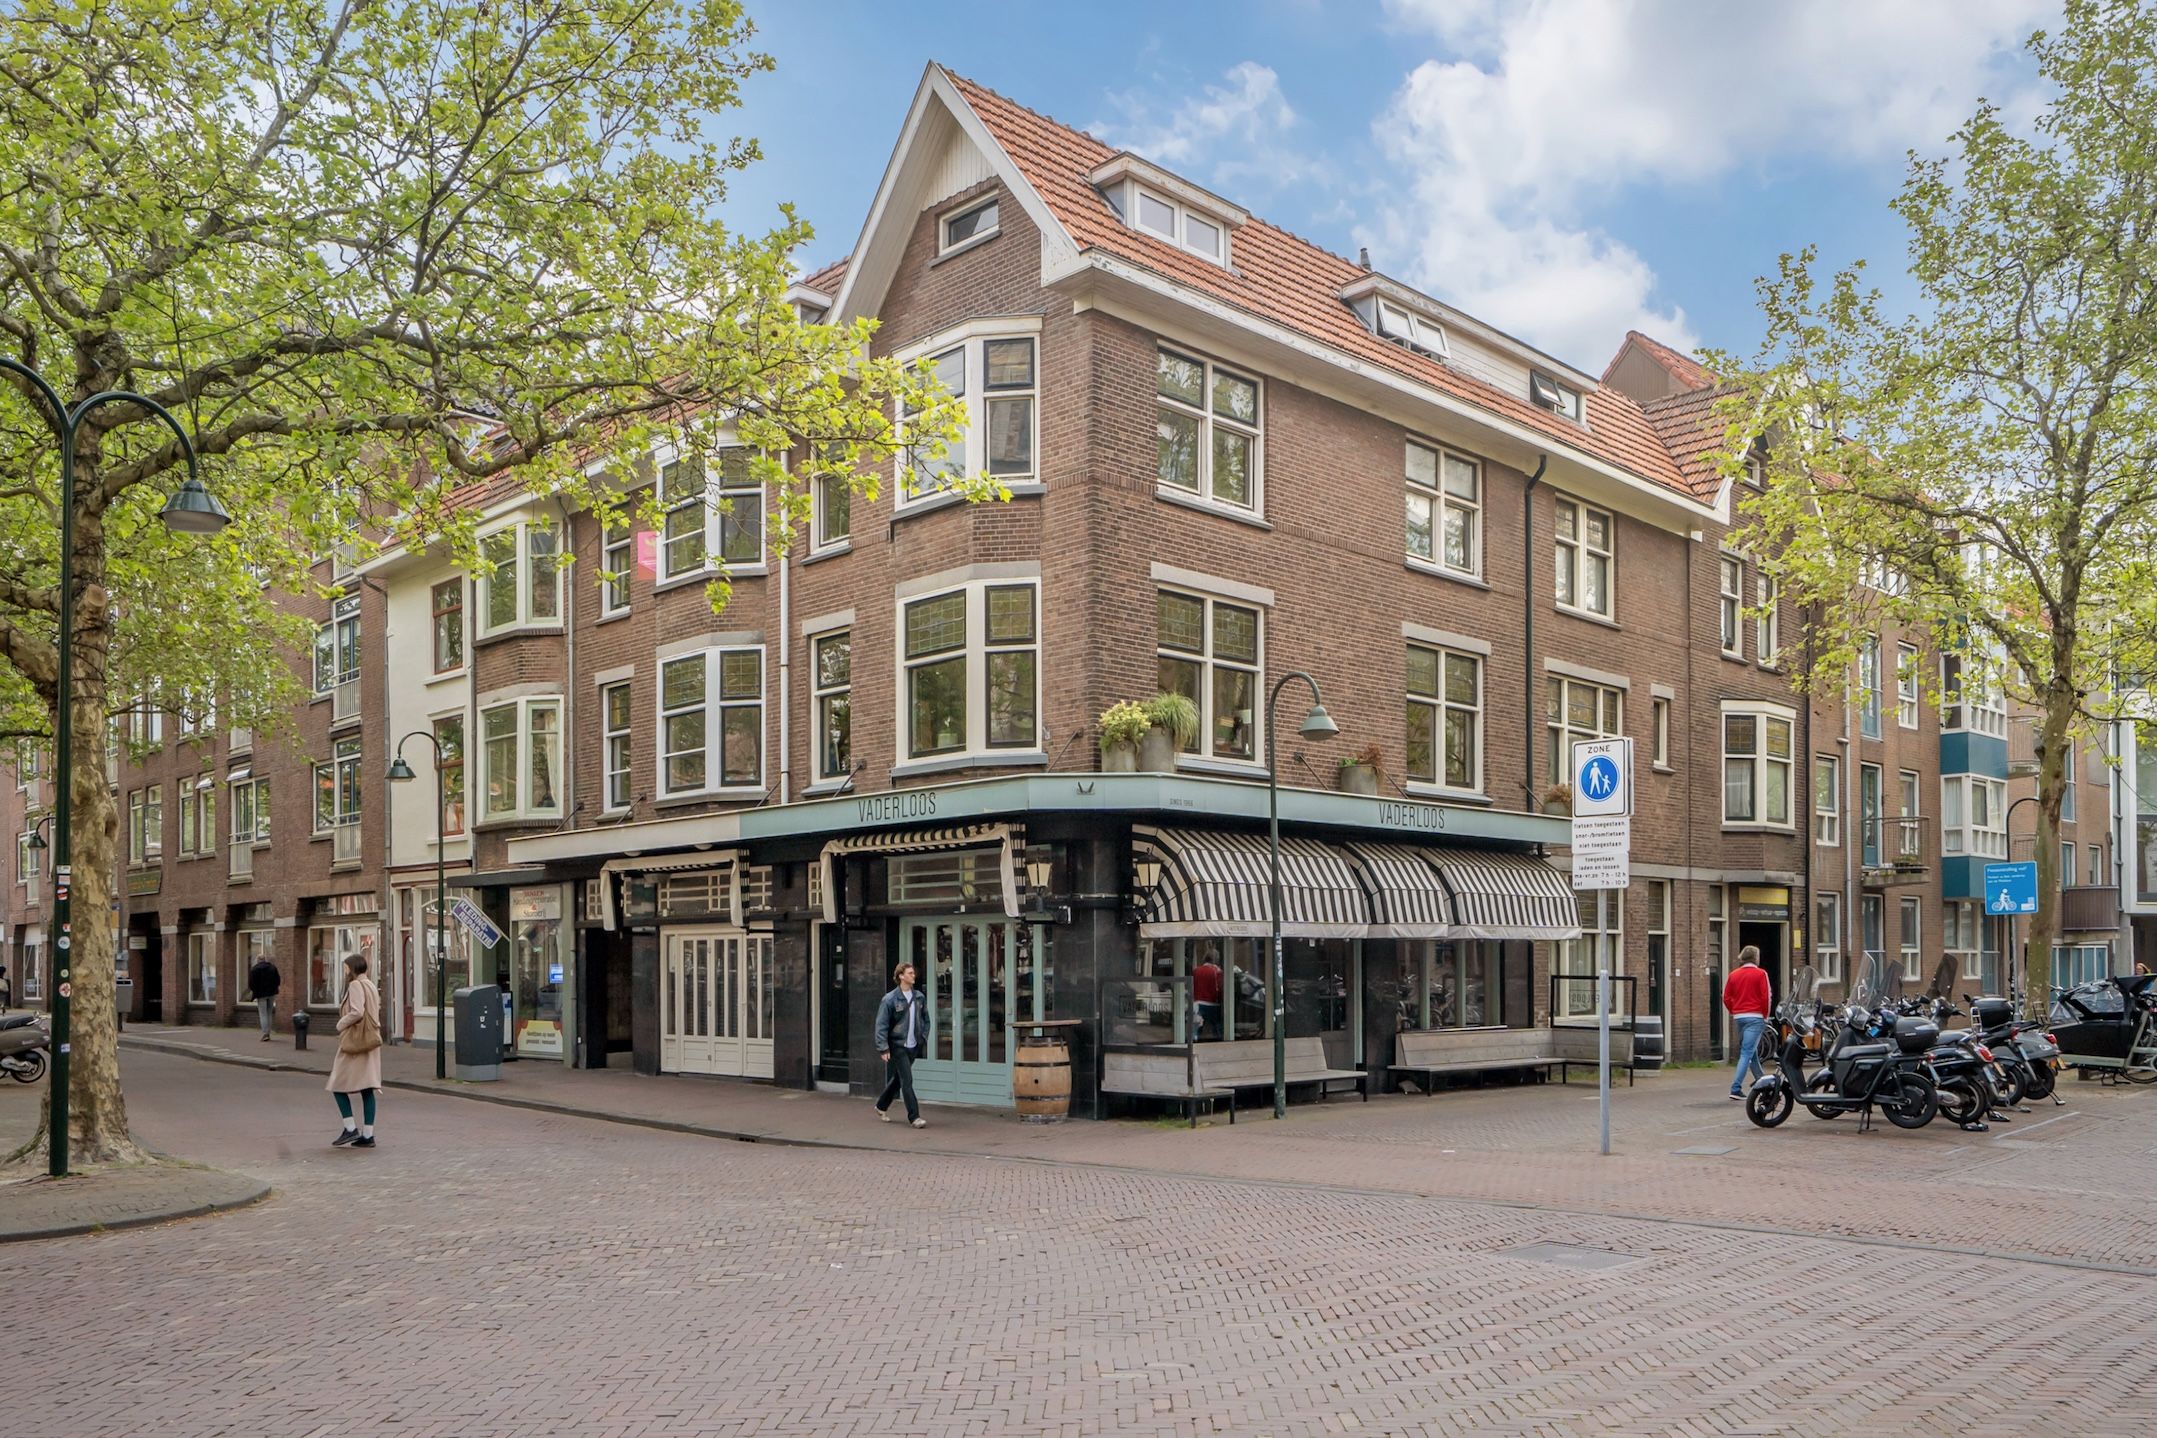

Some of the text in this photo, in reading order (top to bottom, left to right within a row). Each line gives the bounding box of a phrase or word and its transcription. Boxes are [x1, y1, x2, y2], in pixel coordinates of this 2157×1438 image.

[1587, 745, 1611, 754] ZONE
[858, 792, 937, 822] VADERLOOS
[1378, 802, 1445, 829] VADERLOOS
[1594, 821, 1625, 829] toegestaan
[1591, 841, 1622, 849] toegestaan
[1585, 856, 1615, 864] toegestaan
[459, 902, 489, 931] KLEDING-
[459, 911, 494, 946] REPARATIE
